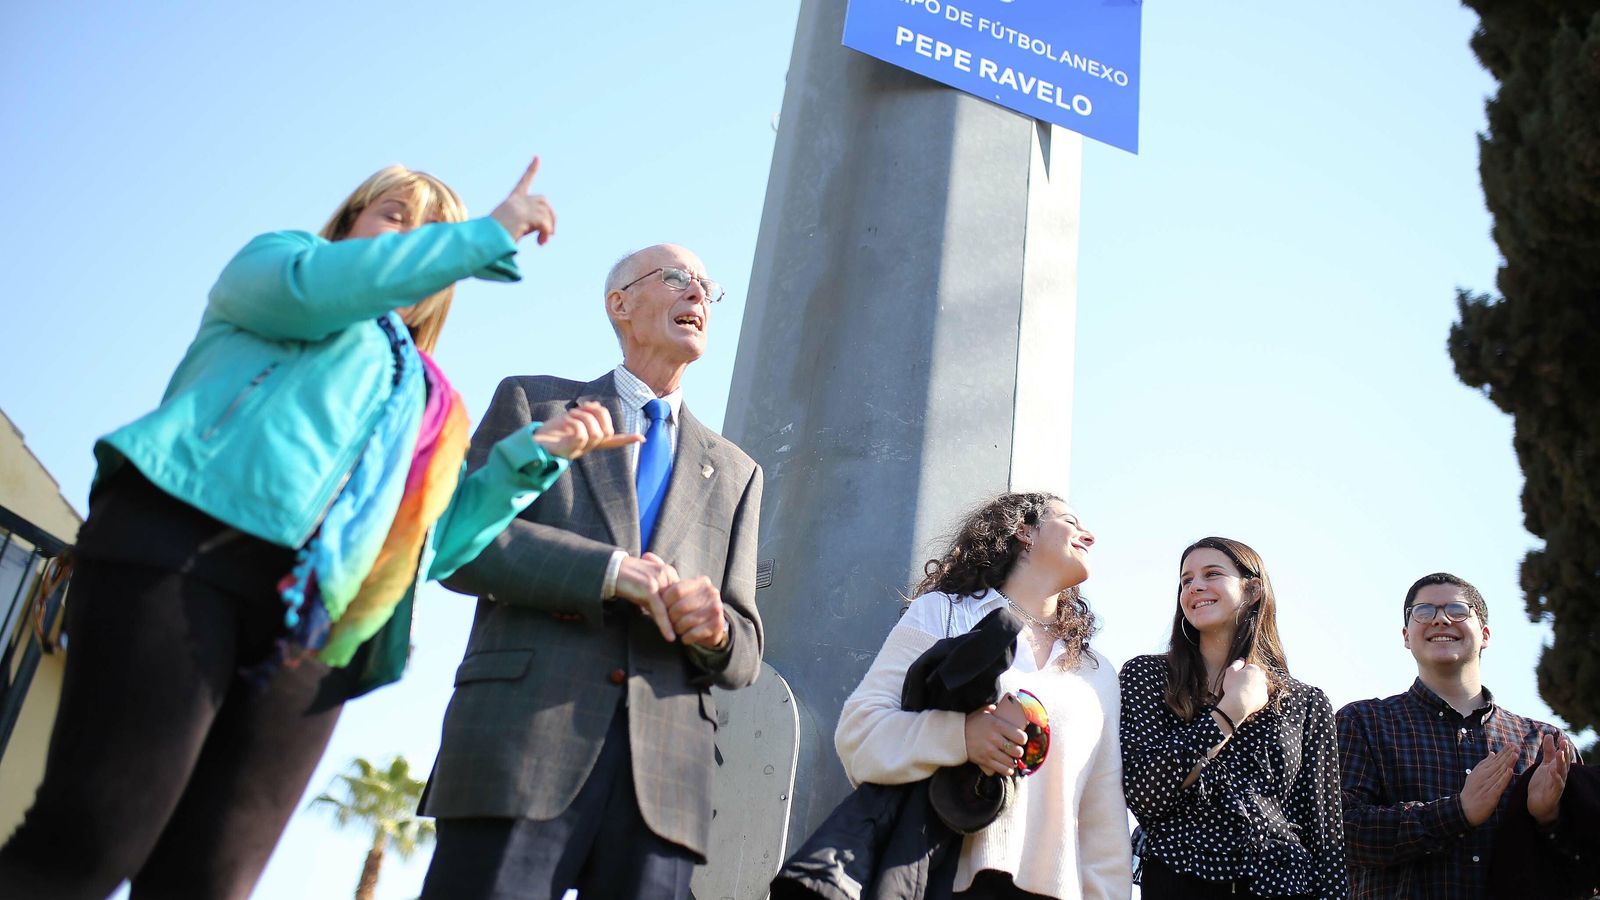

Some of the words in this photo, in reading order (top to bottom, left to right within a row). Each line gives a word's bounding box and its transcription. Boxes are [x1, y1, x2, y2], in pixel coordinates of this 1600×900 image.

[895, 26, 972, 73] PEPE
[979, 58, 1093, 117] RAVELO
[945, 5, 973, 28] DE
[978, 17, 1057, 61] FÚTBOL
[1059, 50, 1129, 87] ANEXO
